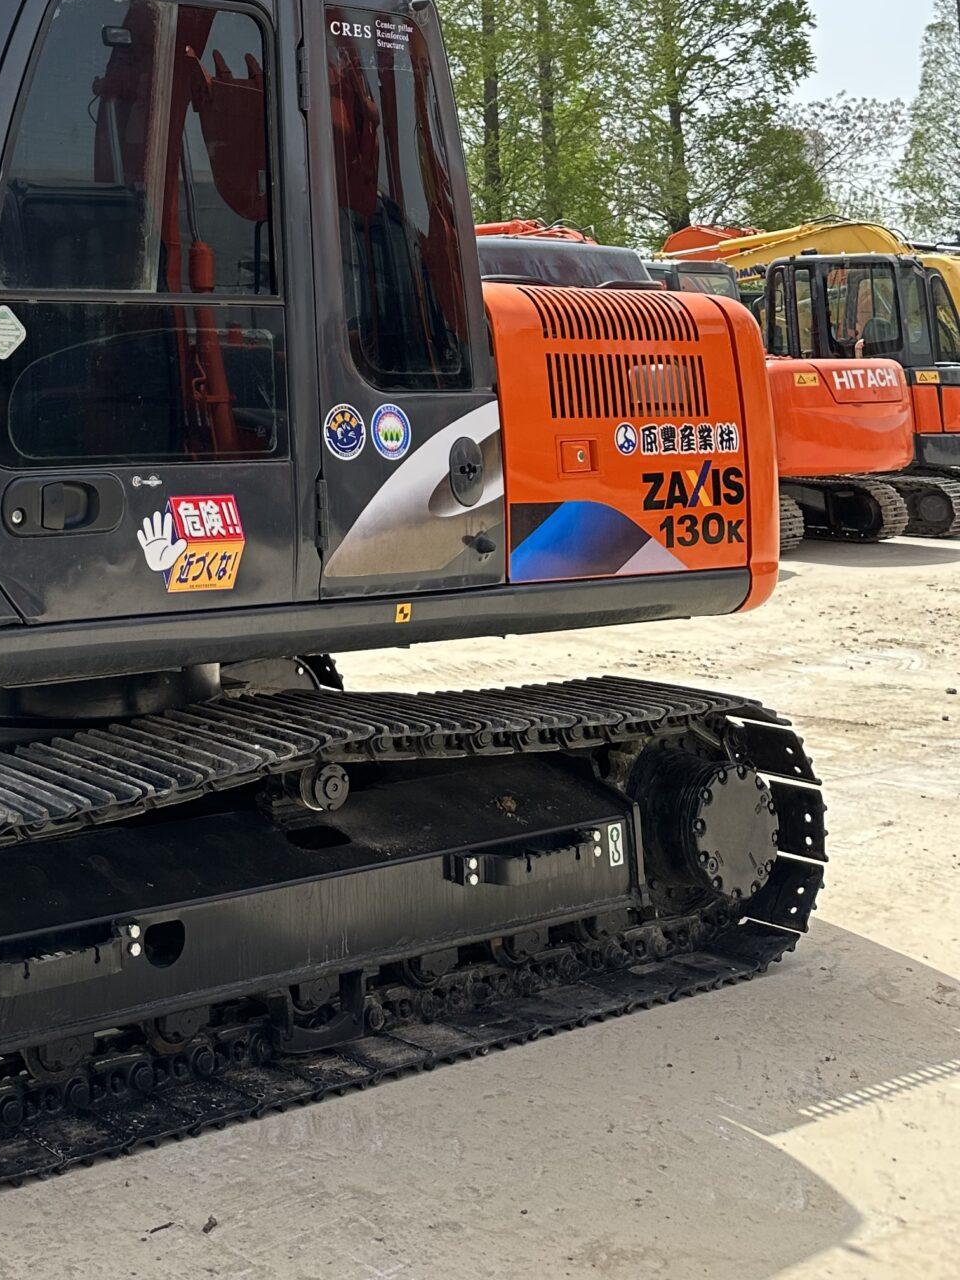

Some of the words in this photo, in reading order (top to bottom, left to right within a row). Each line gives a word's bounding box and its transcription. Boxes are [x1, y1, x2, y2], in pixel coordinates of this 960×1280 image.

[330, 21, 372, 39] CRES
[832, 368, 899, 390] HITACHI
[642, 460, 745, 511] ZAXIS
